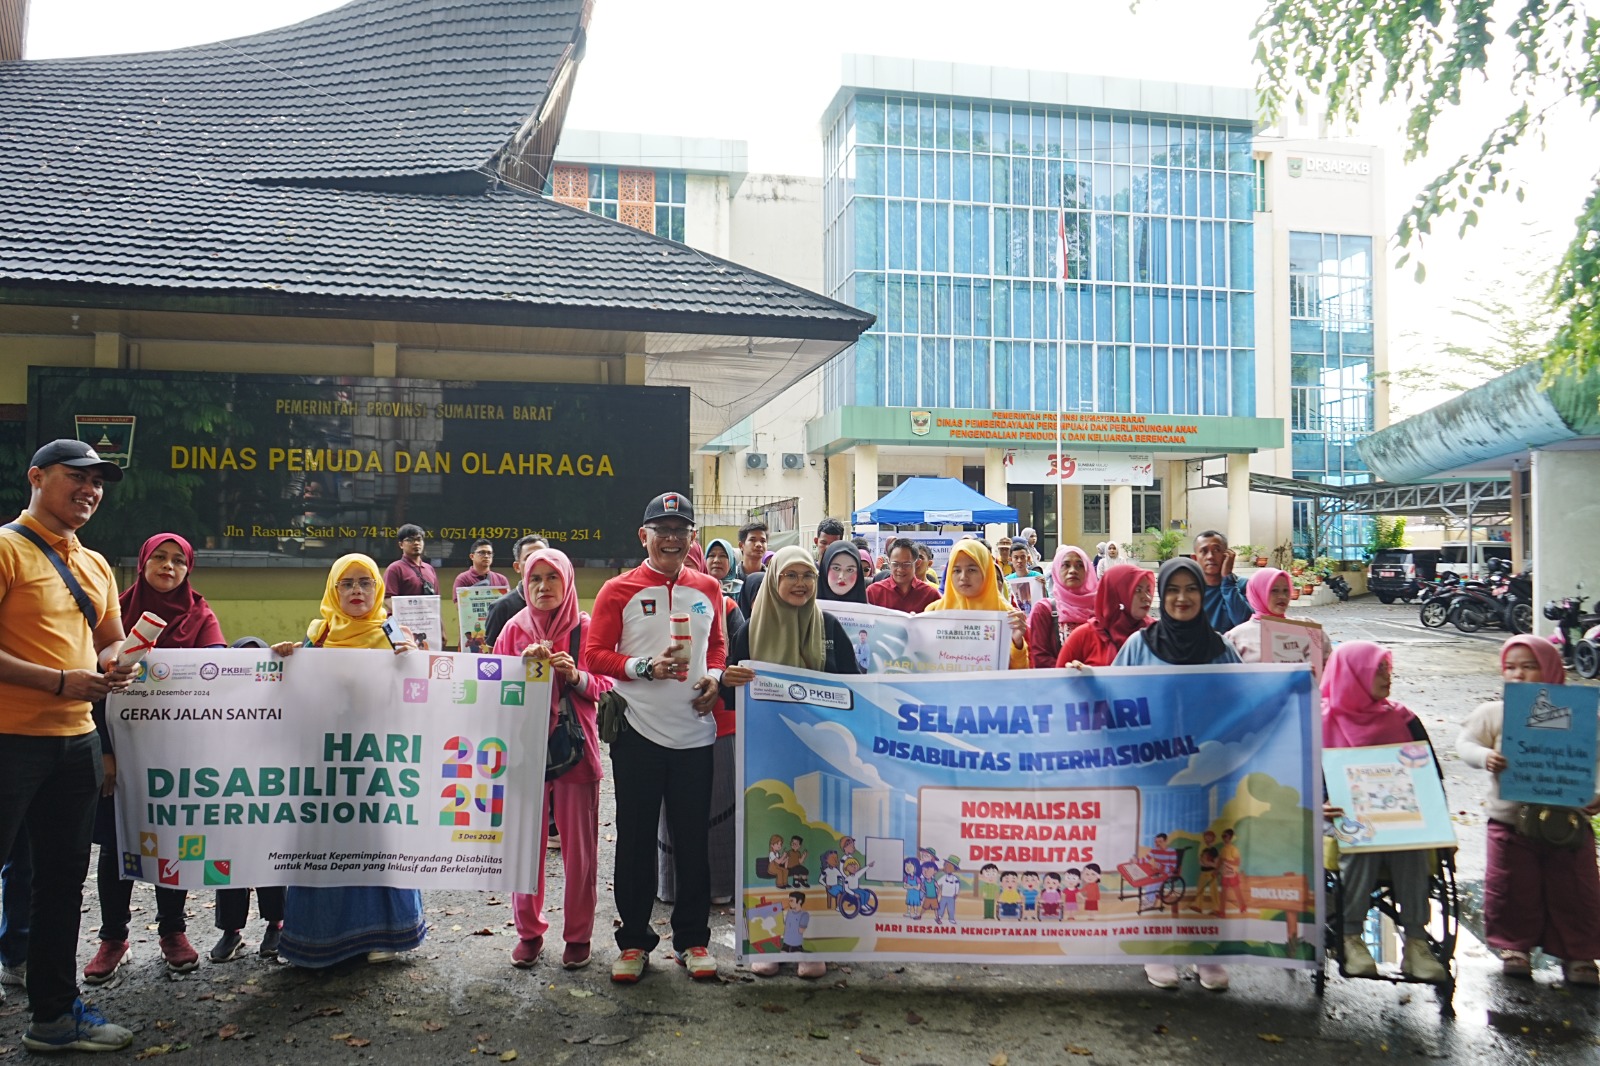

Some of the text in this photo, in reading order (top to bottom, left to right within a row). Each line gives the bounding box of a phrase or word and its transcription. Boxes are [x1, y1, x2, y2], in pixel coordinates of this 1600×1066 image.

[276, 399, 553, 421] PEMERINTAH PROVINSI SUMATERA BARAT
[992, 411, 1040, 421] PEMERINTAH
[1122, 416, 1146, 424] BARAT
[937, 418, 963, 428] DINAS
[965, 419, 1035, 430] PEMBERDAYAAN
[1091, 423, 1108, 431] DAN
[1110, 424, 1174, 433] PERLINDUNGAN
[1175, 425, 1198, 434] ANAK
[950, 429, 1018, 439] PENGENDALIAN
[1068, 433, 1086, 441] DAN
[1088, 434, 1133, 442] KELUARGA
[1135, 435, 1186, 443] BERENCANA
[171, 445, 614, 477] DINAS PEMUDA DAN OLAHRAGA
[223, 525, 244, 537] Jln
[252, 525, 302, 538] Rasuna
[306, 526, 334, 538] Said
[339, 527, 357, 538] No
[361, 526, 377, 538] 74
[938, 651, 991, 664] Memperingati
[255, 661, 284, 672] HDI
[255, 673, 283, 682] 2024
[809, 689, 835, 700] PKBI
[120, 708, 282, 721] GERAK JALAN SANTAI
[898, 697, 1152, 734] SELAMAT HARI
[323, 732, 422, 764] HARI
[873, 735, 1200, 772] DISABILITAS INTERNASIONAL
[442, 735, 508, 780] 20
[147, 766, 421, 798] DISABILITAS
[439, 783, 504, 828] 24
[961, 801, 1101, 820] NORMALISASI
[147, 802, 420, 827] INTERNASIONAL
[960, 822, 1097, 841] KEBERADAAN
[268, 851, 503, 864] Memperkuat Kepemimpinan Penyandang Disabilitas
[969, 845, 1094, 863] DISABILITAS
[274, 862, 502, 875] untuk Masa Depan yang Inklusif dan Berkelanjutan
[1250, 887, 1299, 901] INKLUSI
[875, 923, 1219, 937] MARI BERSAMA MENCIPTAKAN LINGKUNGAN YANG LEBIH INKLUSI
